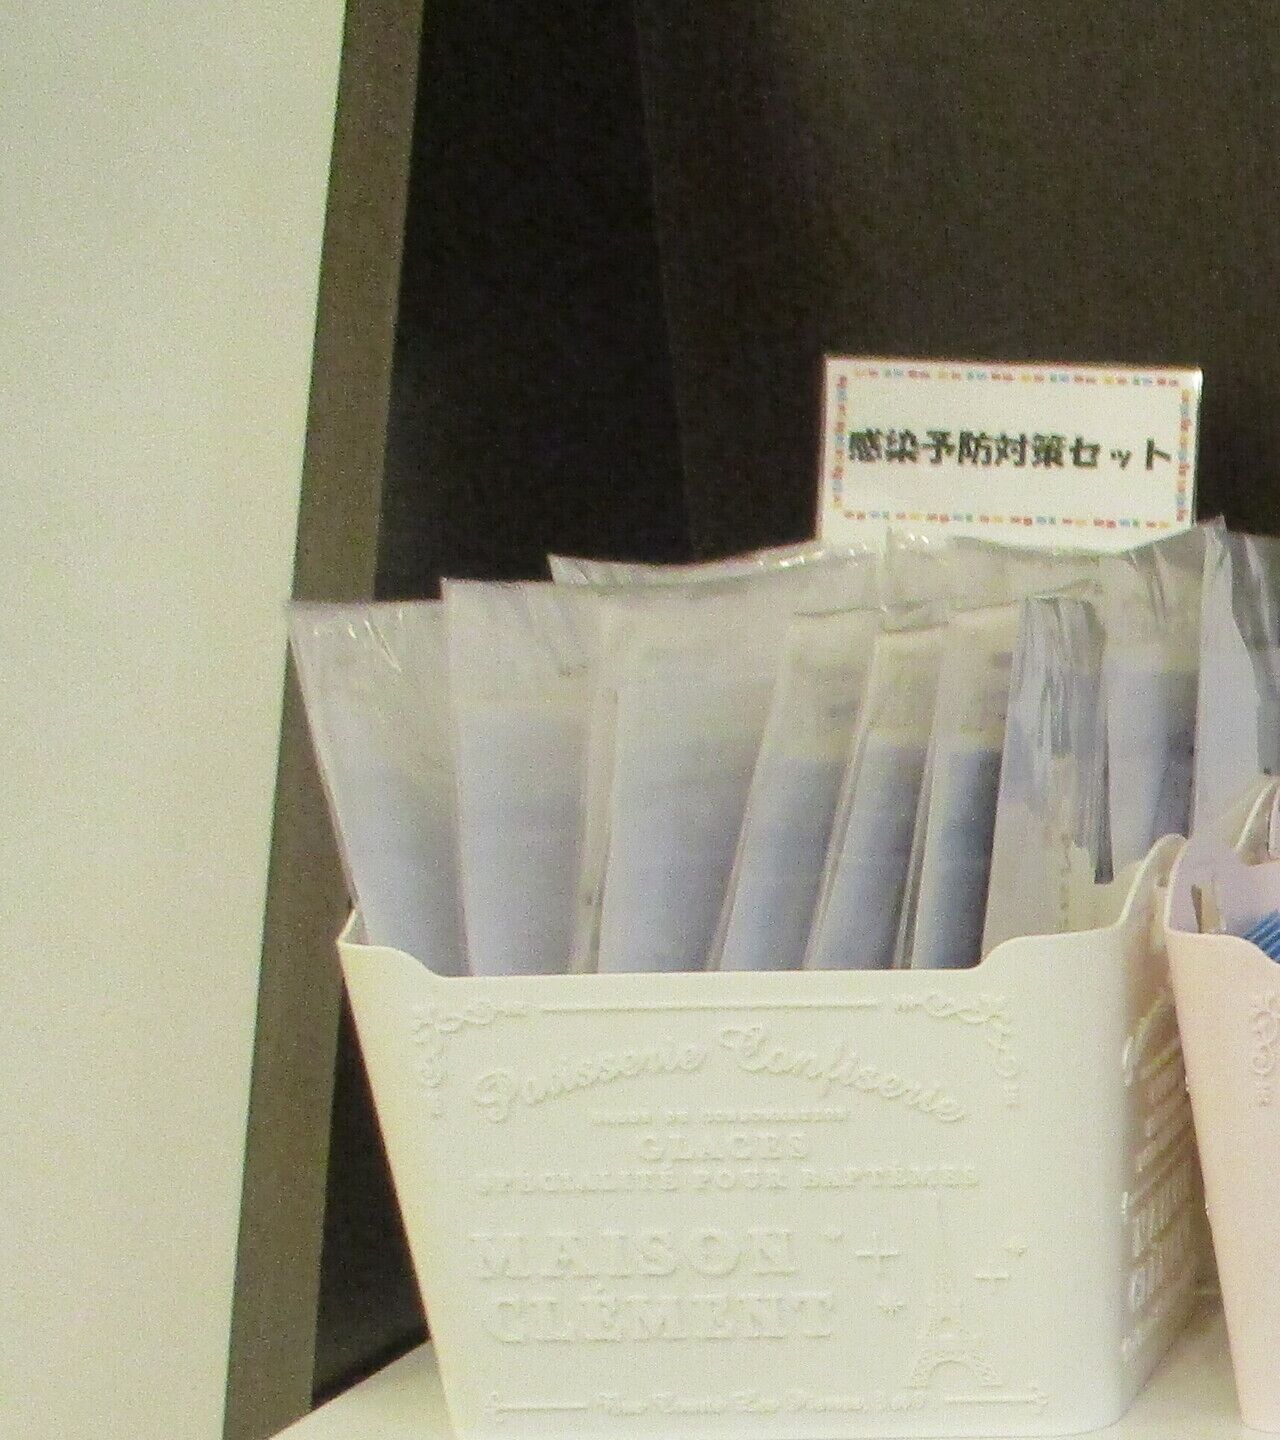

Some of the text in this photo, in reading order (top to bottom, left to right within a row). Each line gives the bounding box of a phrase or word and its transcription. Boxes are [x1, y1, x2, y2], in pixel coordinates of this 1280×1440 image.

[847, 427, 1174, 470] 感染予防対策セット
[719, 1022, 966, 1123] Confiserie
[636, 1131, 812, 1162] GLACES
[469, 1226, 798, 1281] MAISON
